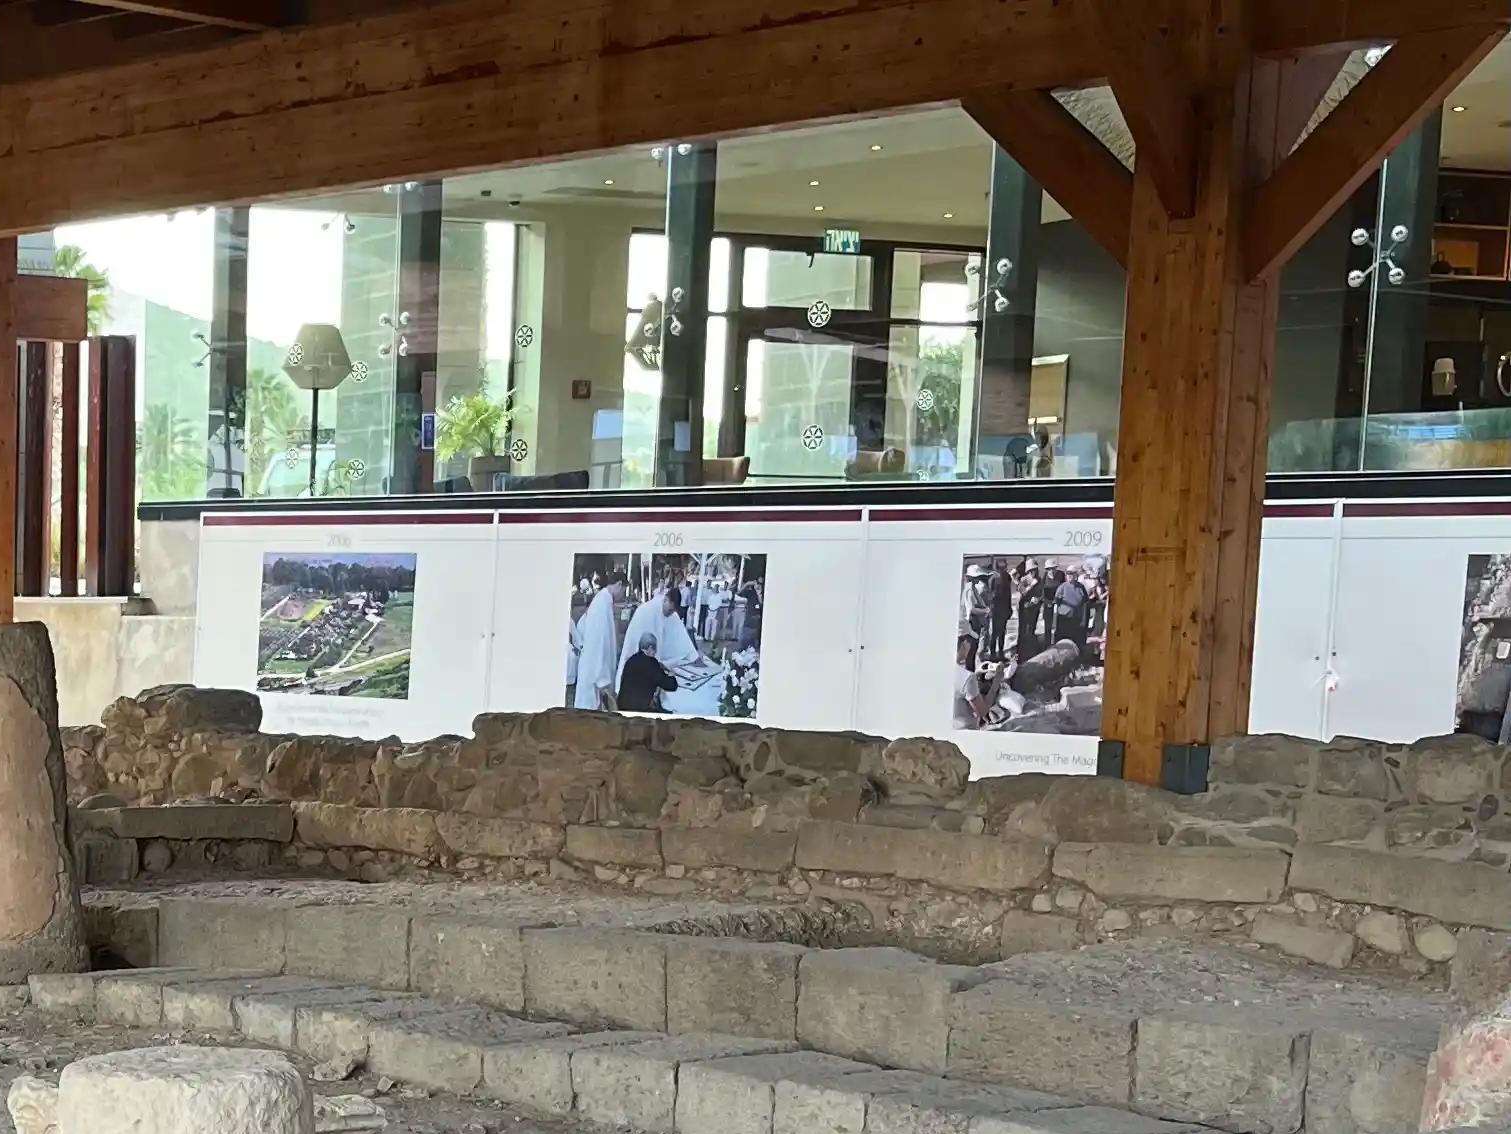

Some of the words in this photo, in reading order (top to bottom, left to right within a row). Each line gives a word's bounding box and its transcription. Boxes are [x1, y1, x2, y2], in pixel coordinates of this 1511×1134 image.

[825, 229, 860, 252] יציאה
[652, 532, 684, 547] 2006
[1063, 530, 1102, 547] 2009
[995, 751, 1049, 766] Uncovering
[1052, 753, 1069, 765] The
